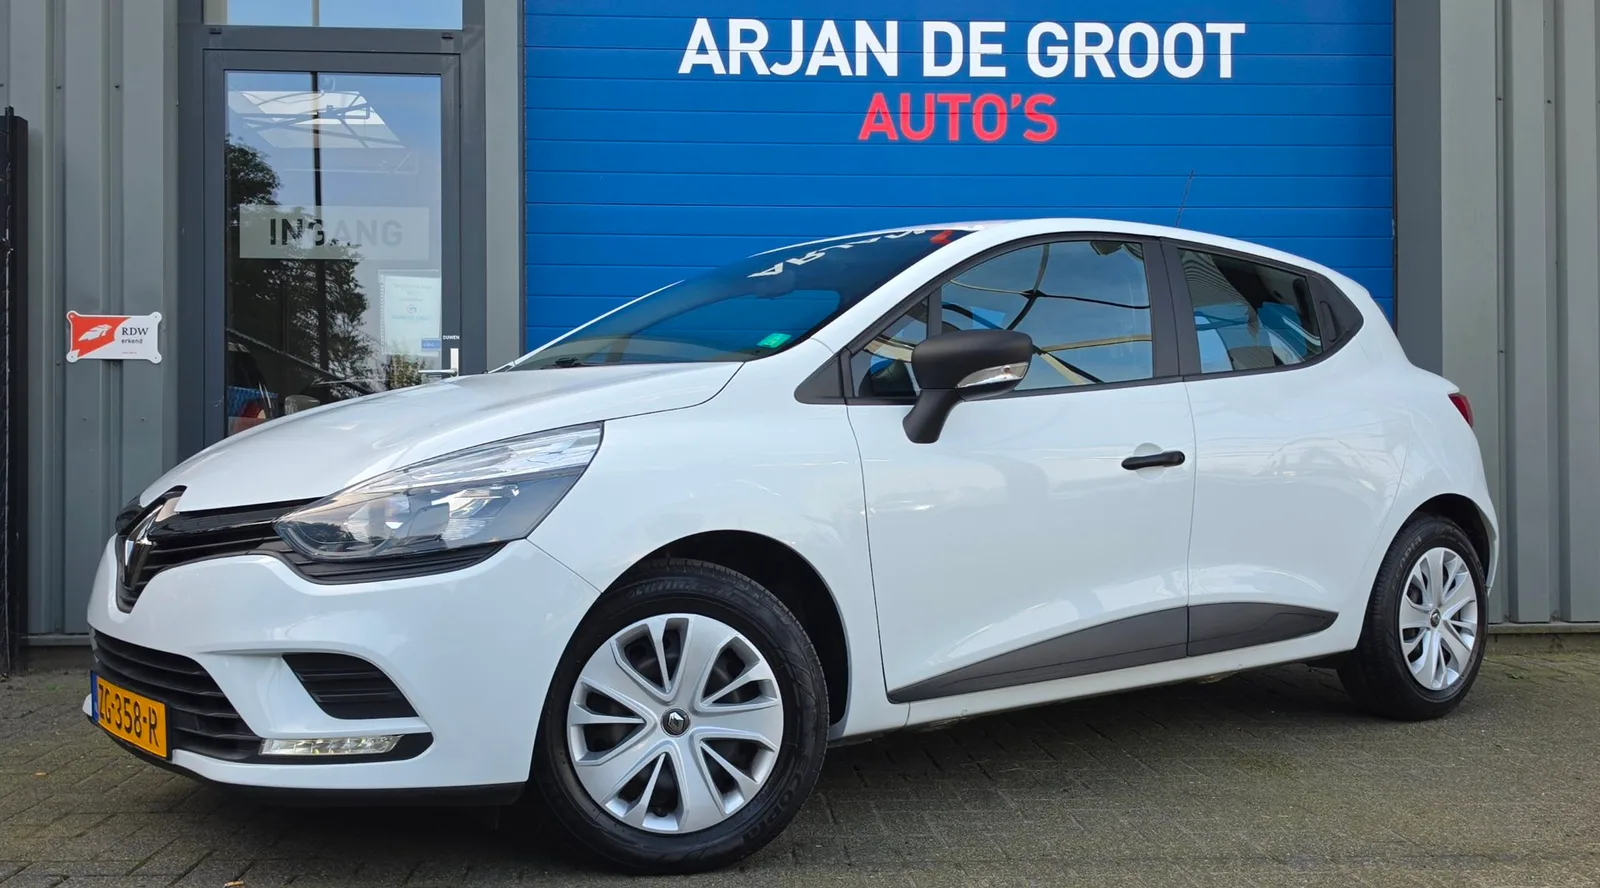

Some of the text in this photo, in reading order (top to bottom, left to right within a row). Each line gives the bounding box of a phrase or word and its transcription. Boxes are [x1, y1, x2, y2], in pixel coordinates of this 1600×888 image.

[678, 18, 1247, 79] ARJAN DE GROOT
[858, 92, 1059, 142] AUTO'S
[269, 217, 404, 247] INGANG
[121, 327, 149, 336] RDW
[98, 683, 159, 748] ZG-358-R
